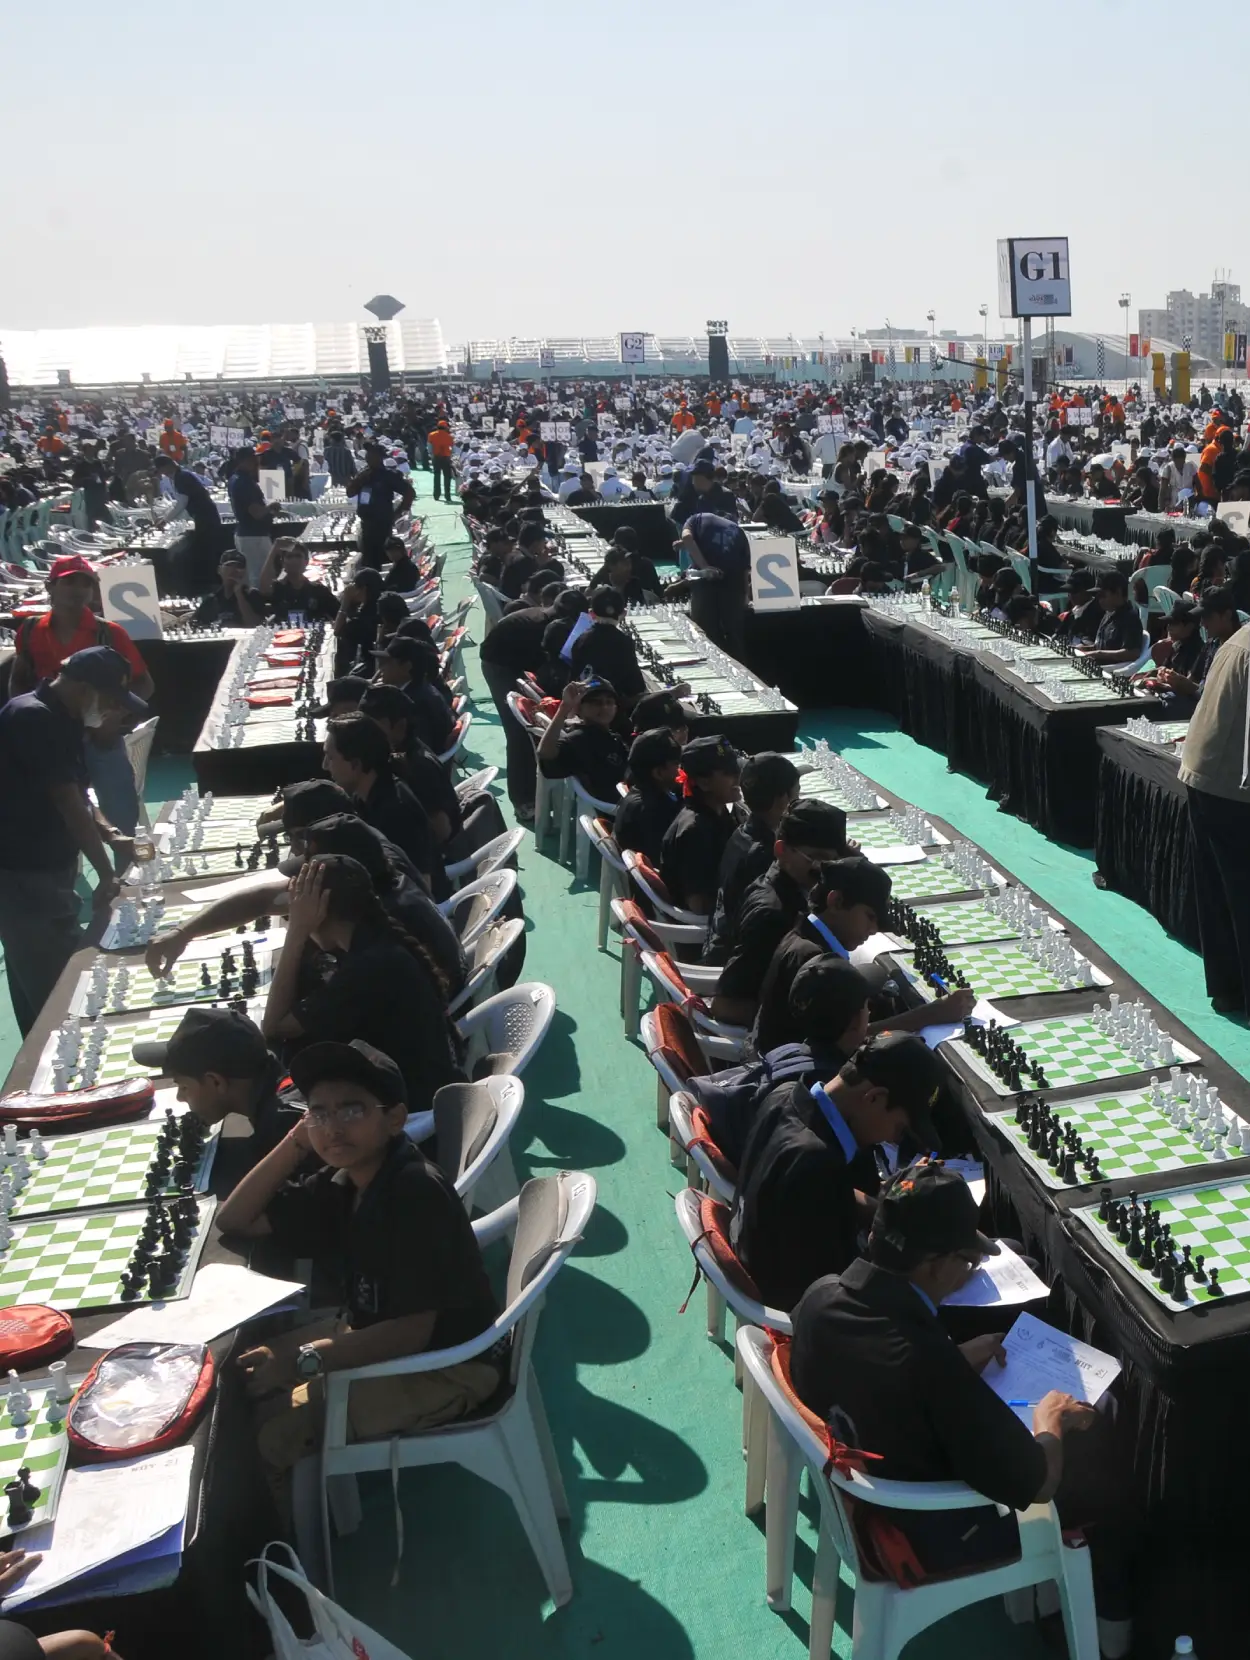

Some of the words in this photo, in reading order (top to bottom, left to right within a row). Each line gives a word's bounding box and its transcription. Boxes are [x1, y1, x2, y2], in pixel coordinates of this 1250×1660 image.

[1019, 251, 1066, 282] G1
[624, 338, 642, 350] G2
[1074, 1359, 1093, 1372] NIIT
